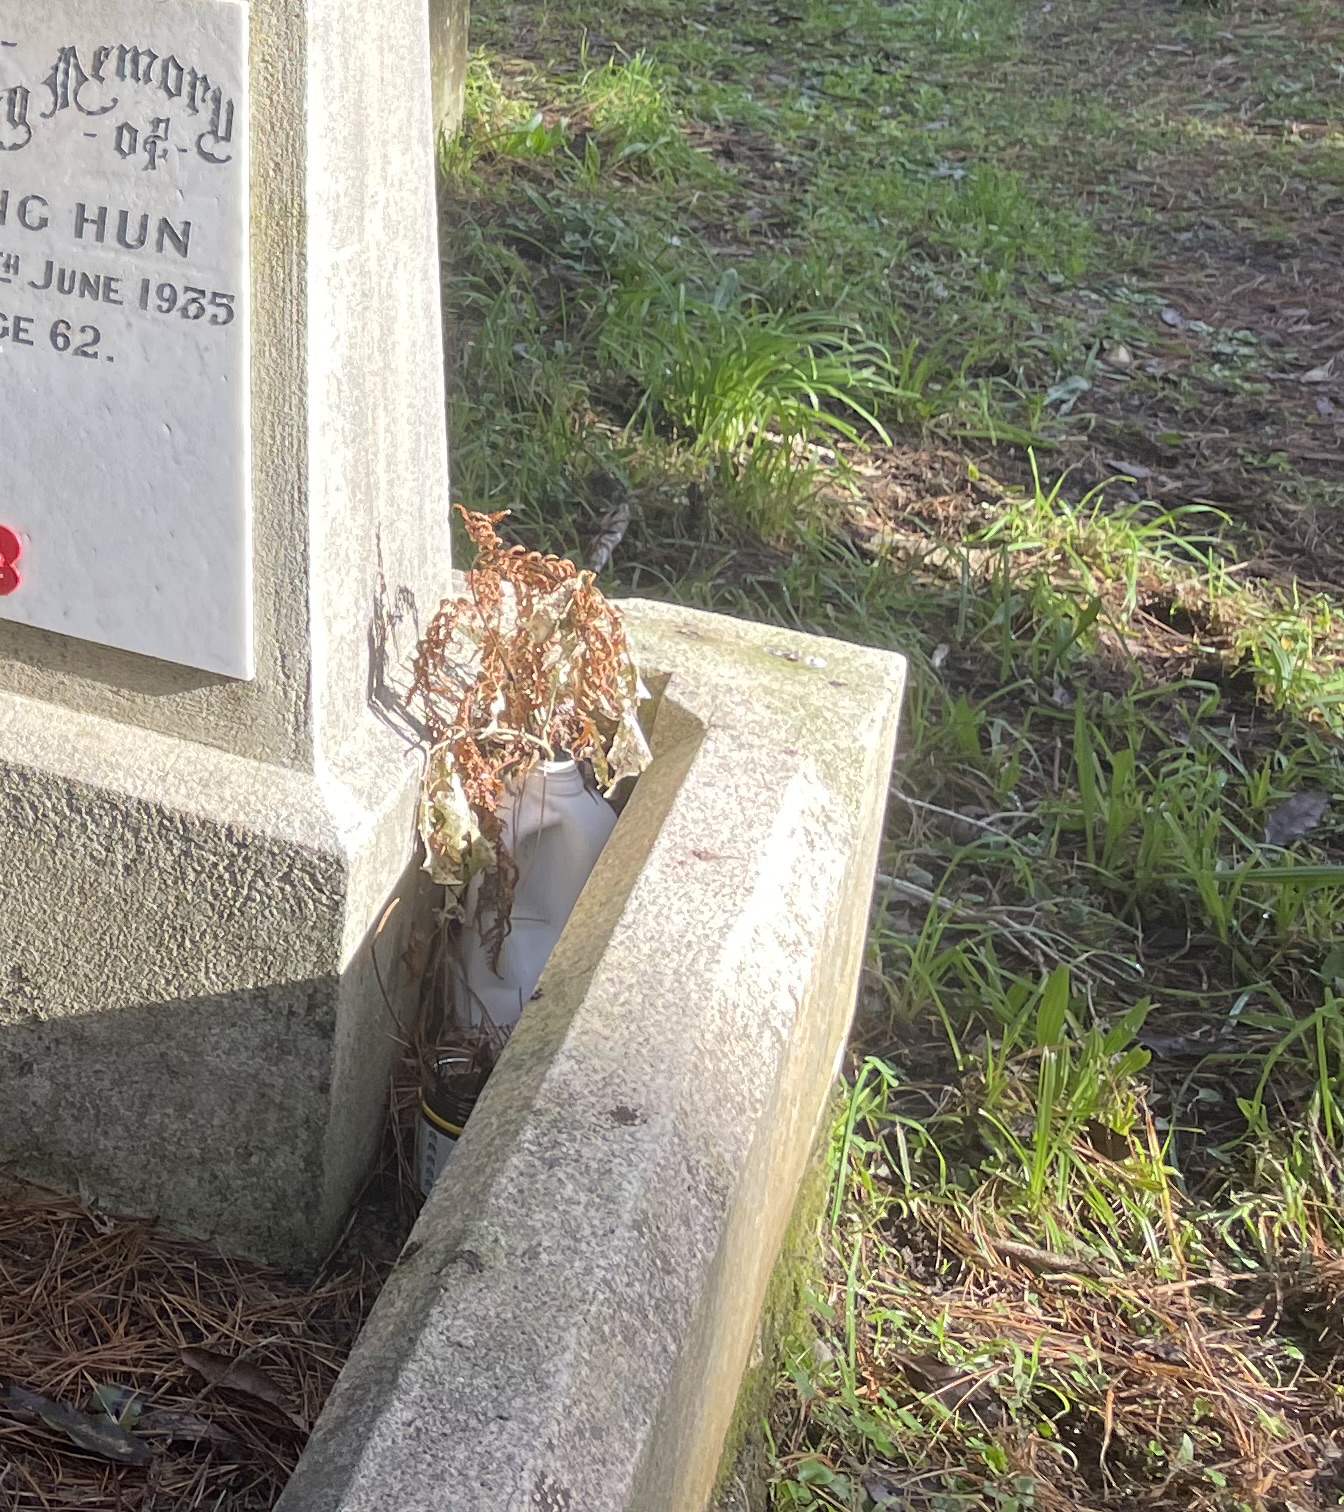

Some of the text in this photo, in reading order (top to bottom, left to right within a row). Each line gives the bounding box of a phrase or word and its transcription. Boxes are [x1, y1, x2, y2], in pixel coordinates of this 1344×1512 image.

[40, 43, 234, 165] Memory
[74, 201, 192, 259] HUN
[27, 259, 124, 307] JUNE
[139, 277, 235, 326] 1935
[49, 319, 115, 363] 62.
